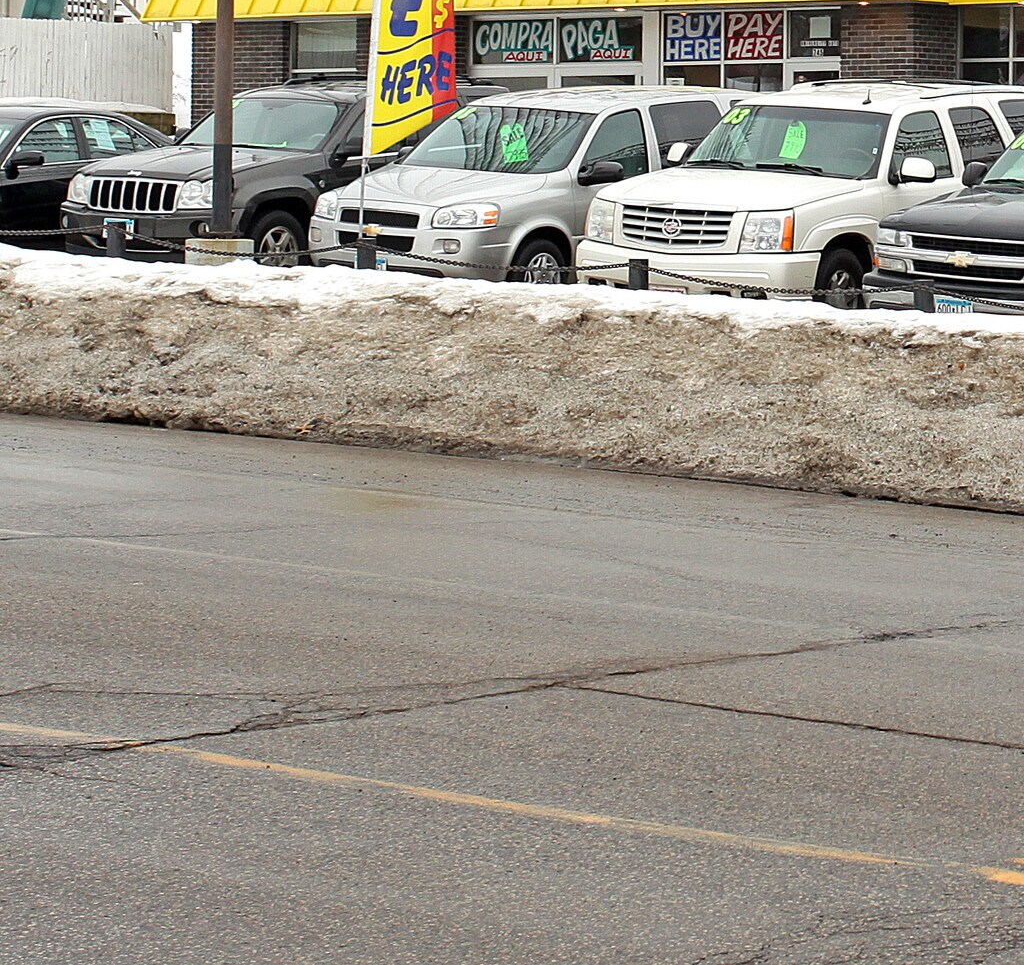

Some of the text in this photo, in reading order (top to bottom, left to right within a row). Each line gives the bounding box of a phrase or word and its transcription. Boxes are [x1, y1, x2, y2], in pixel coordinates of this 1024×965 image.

[666, 13, 721, 37] BUY
[727, 13, 783, 37] PAY
[475, 21, 553, 55] COMPRA
[561, 19, 619, 60] PAGA
[666, 37, 721, 61] HERE
[727, 36, 782, 58] HERE
[504, 51, 543, 62] AQUI
[592, 48, 631, 59] AQUI
[380, 51, 453, 105] HERE
[722, 107, 753, 125] 03
